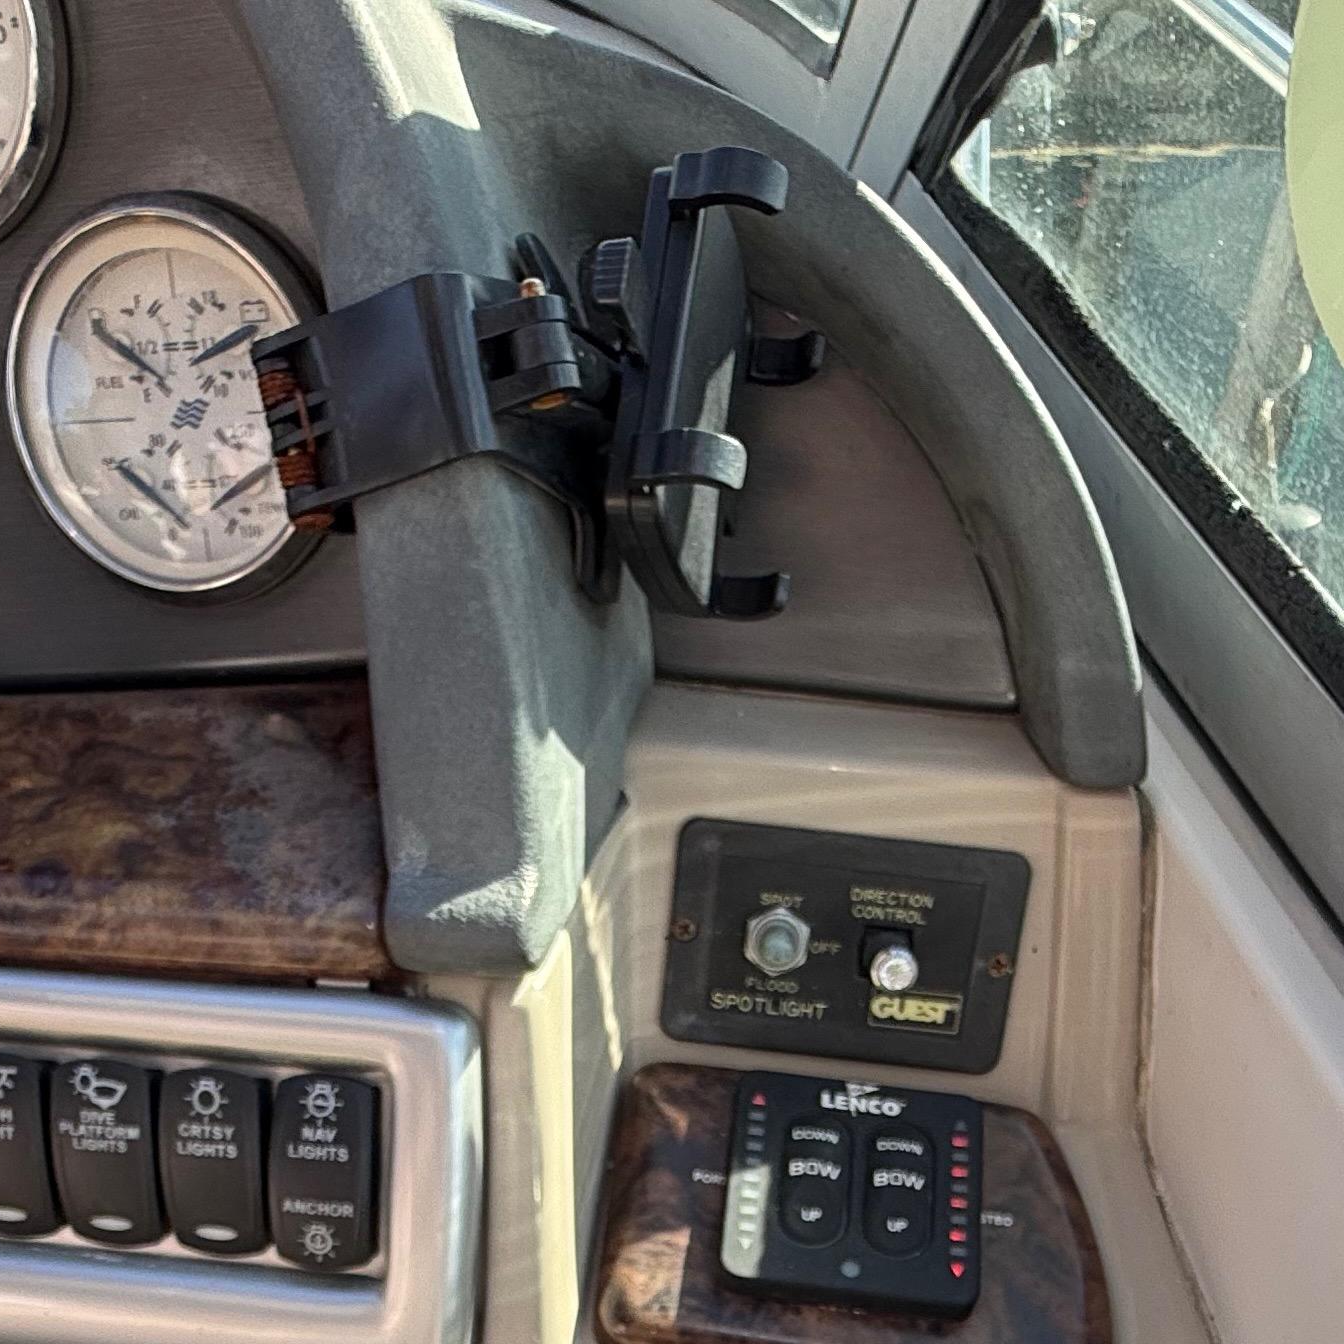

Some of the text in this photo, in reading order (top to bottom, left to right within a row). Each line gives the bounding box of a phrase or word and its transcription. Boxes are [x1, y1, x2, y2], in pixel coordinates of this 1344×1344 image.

[760, 891, 804, 907] SPOT
[850, 886, 936, 910] DIRECTION
[852, 905, 928, 926] CONTROL
[810, 940, 842, 957] OFF
[745, 976, 800, 995] FLOOD
[710, 992, 828, 1020] SPOTLIGHT
[869, 996, 954, 1025] GUEST
[819, 1089, 904, 1118] LENCO
[58, 1120, 141, 1141] PLATFORM
[177, 1122, 236, 1142] CRTSY
[301, 1126, 339, 1143] NAV
[791, 1126, 840, 1145] DOWN
[72, 1137, 129, 1154] LIGHTS
[176, 1141, 239, 1160] LIGHTS
[287, 1143, 350, 1163] LIGHTS
[876, 1136, 925, 1156] DOWN
[788, 1157, 842, 1181] BOW
[873, 1168, 926, 1191] BOW
[282, 1199, 355, 1218] ANCHOR
[800, 1206, 824, 1222] UP
[886, 1216, 910, 1233] UP
